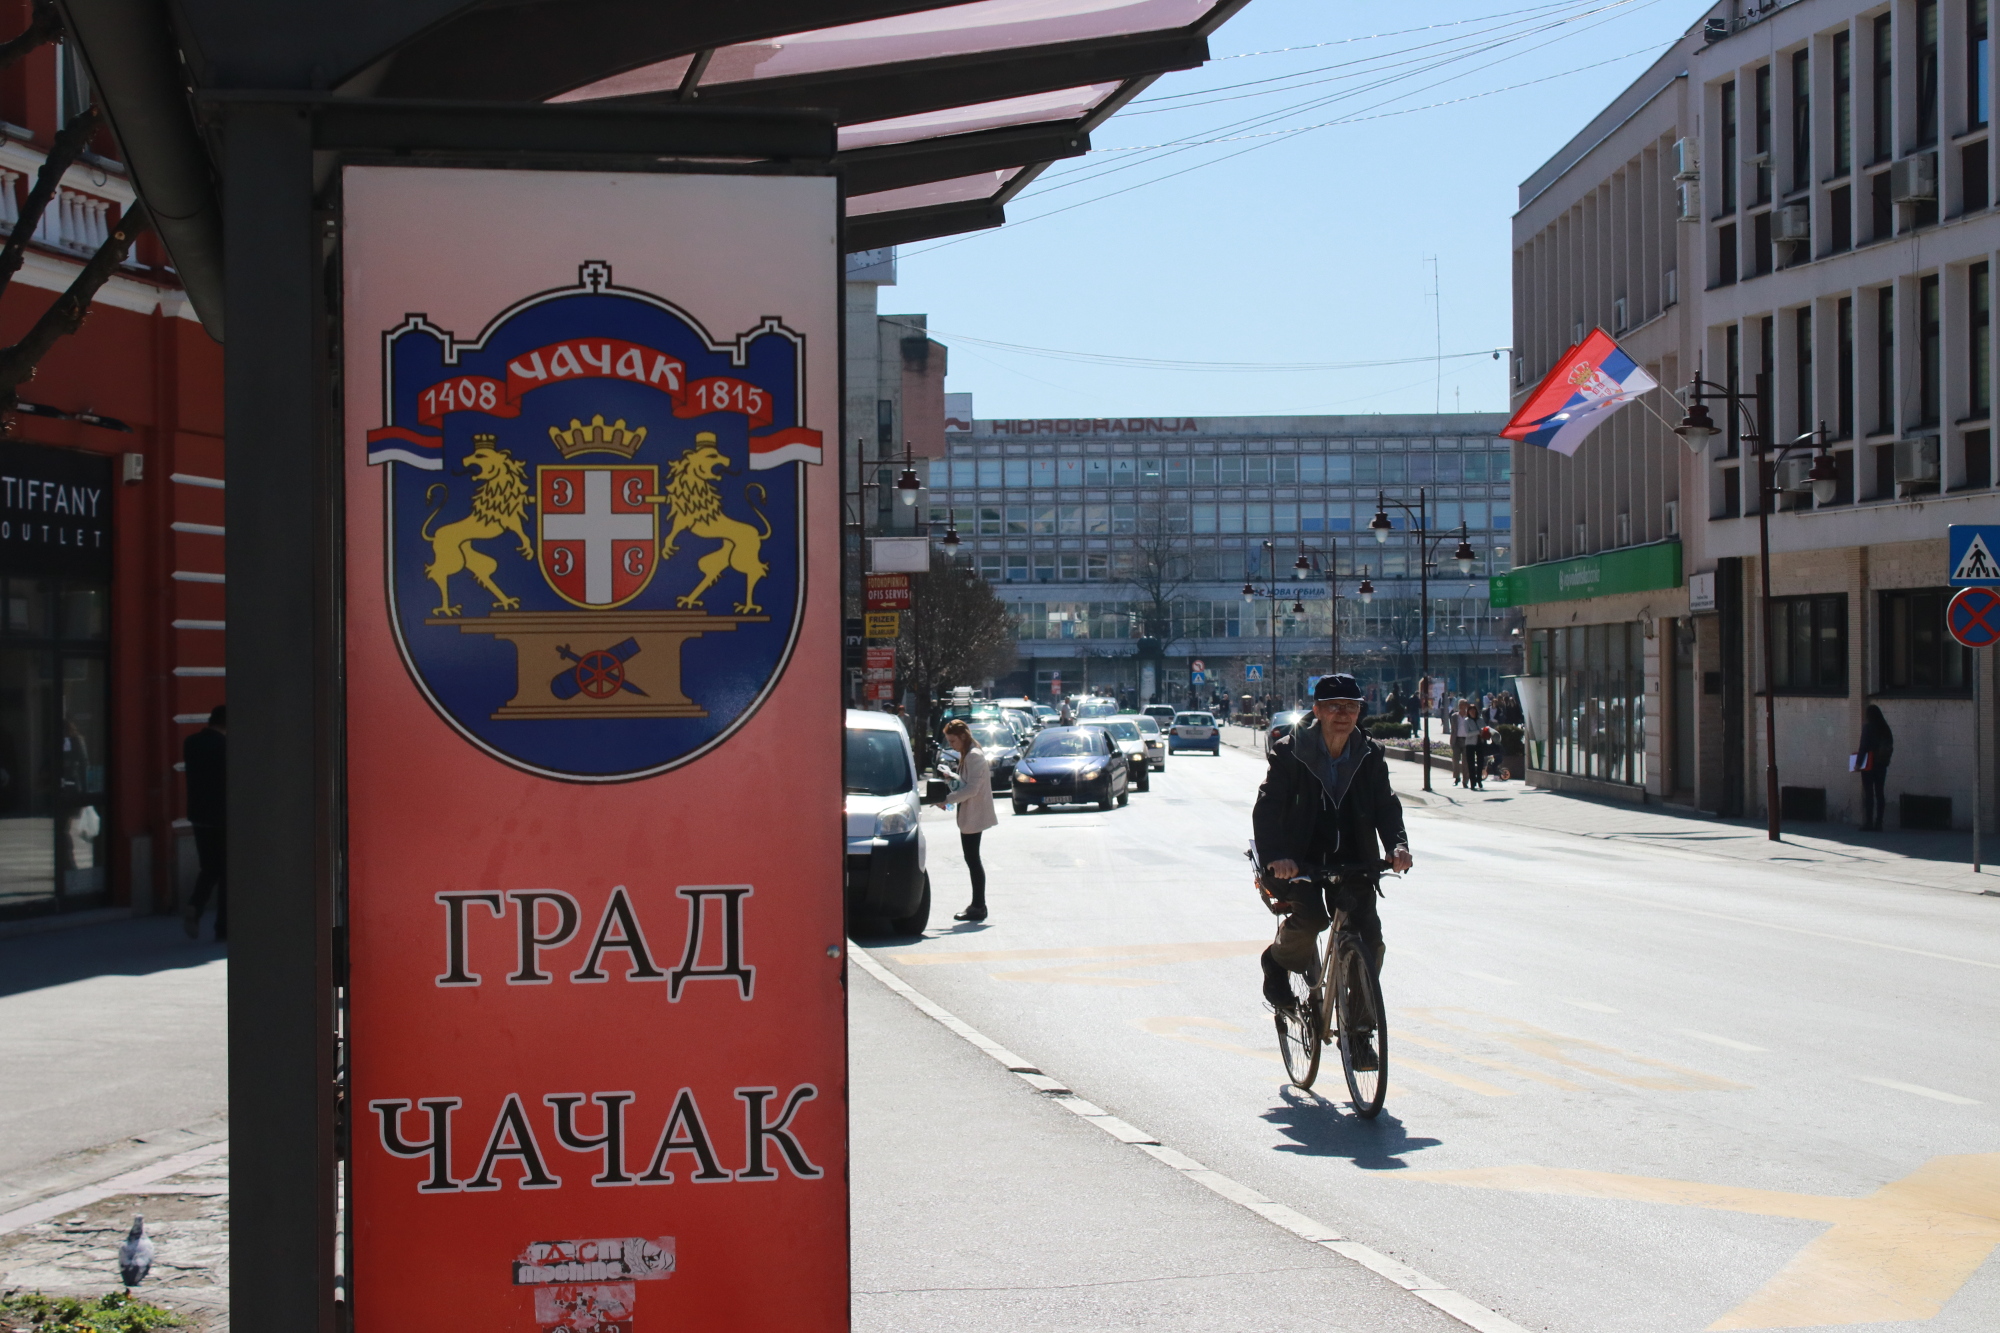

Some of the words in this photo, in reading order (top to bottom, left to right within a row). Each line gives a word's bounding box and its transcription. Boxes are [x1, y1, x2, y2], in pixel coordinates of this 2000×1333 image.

[509, 343, 683, 391] ЧАЧАК
[424, 378, 498, 414] 1408
[695, 380, 764, 415] 1815
[992, 417, 1198, 435] HIDROGRADNJA
[1, 476, 101, 518] TIFFANY
[1, 521, 101, 547] OUTLET
[868, 590, 884, 600] OFIS
[885, 589, 909, 600] SERVIS
[434, 884, 756, 1003] ГРАД
[368, 1082, 824, 1194] ЧАЧАК
